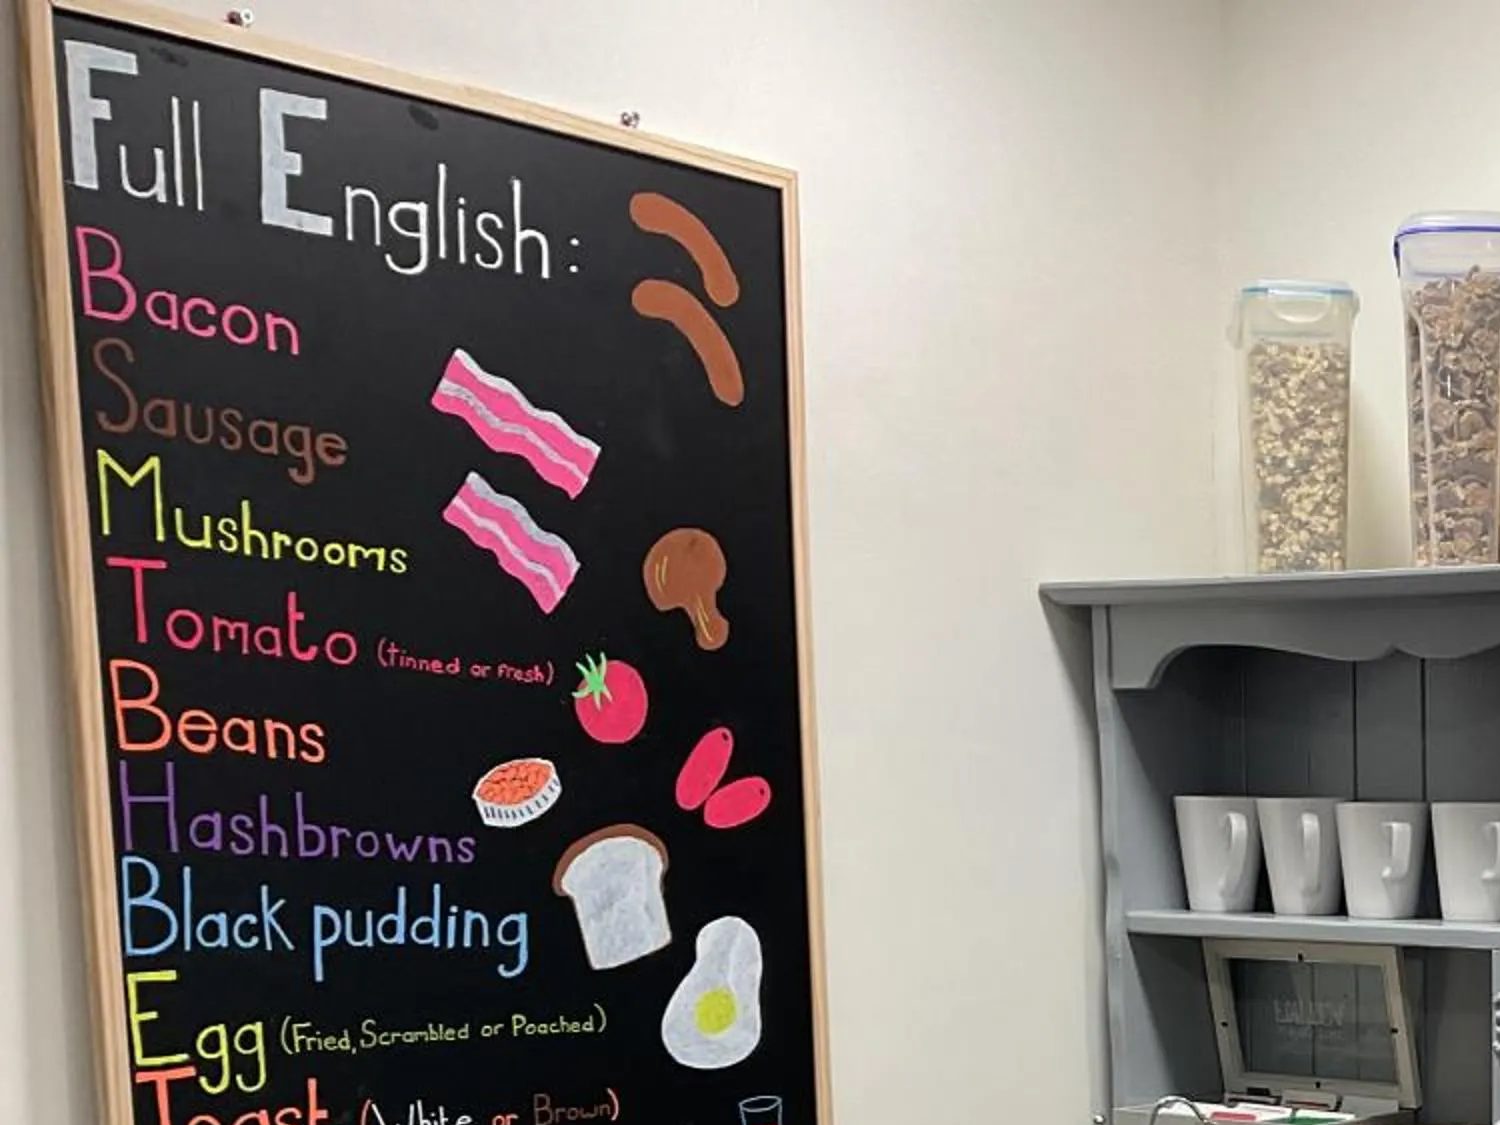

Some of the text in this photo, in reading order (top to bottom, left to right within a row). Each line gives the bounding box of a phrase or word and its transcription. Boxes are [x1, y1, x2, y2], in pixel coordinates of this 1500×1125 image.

[63, 40, 581, 280] Full English:
[76, 226, 300, 356] Bacon
[93, 338, 348, 485] Sausage
[97, 449, 407, 575] Mushrooms
[107, 558, 554, 686] Tomato (tinned or fresh)
[110, 660, 327, 763] Beans
[120, 758, 477, 865] Hashbrowns
[122, 856, 528, 982] Black pudding
[126, 971, 266, 1092] Egg
[360, 1019, 469, 1048] Scrambled
[481, 1024, 504, 1037] or
[512, 1003, 607, 1036] Poached)
